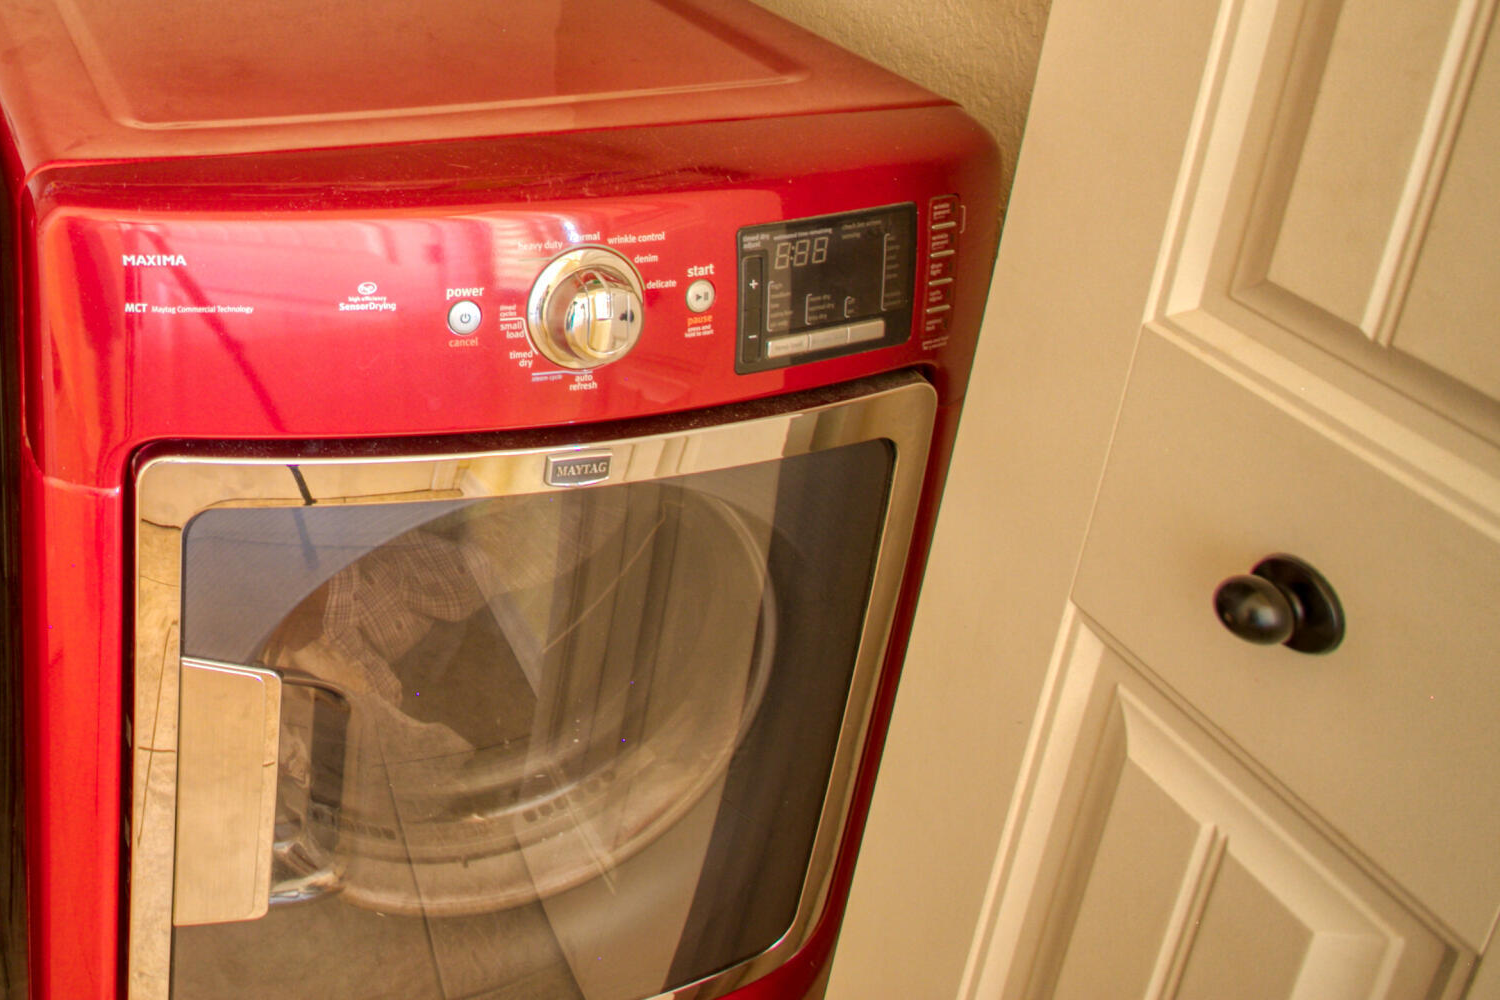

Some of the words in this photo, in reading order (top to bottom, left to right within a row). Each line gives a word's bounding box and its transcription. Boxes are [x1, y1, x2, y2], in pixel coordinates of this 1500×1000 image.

[607, 235, 636, 245] wrinkle
[637, 232, 666, 243] control
[518, 241, 542, 251] heavy
[544, 240, 563, 250] duty
[122, 254, 187, 266] MAXIMA
[634, 254, 658, 264] denim
[687, 263, 714, 278] start
[646, 279, 677, 289] delicate
[446, 285, 484, 300] power
[124, 303, 147, 313] MCT
[151, 305, 176, 314] Maytag
[177, 305, 216, 313] Commercial
[217, 305, 254, 314] Technology
[338, 302, 396, 312] SensorDrying
[500, 321, 523, 331] small
[506, 330, 524, 339] load
[449, 337, 479, 348] cancel
[509, 350, 533, 360] timed
[518, 359, 533, 368] dry
[574, 374, 593, 382] auto
[569, 381, 598, 391] refresh
[556, 462, 607, 477] MAYTAG
